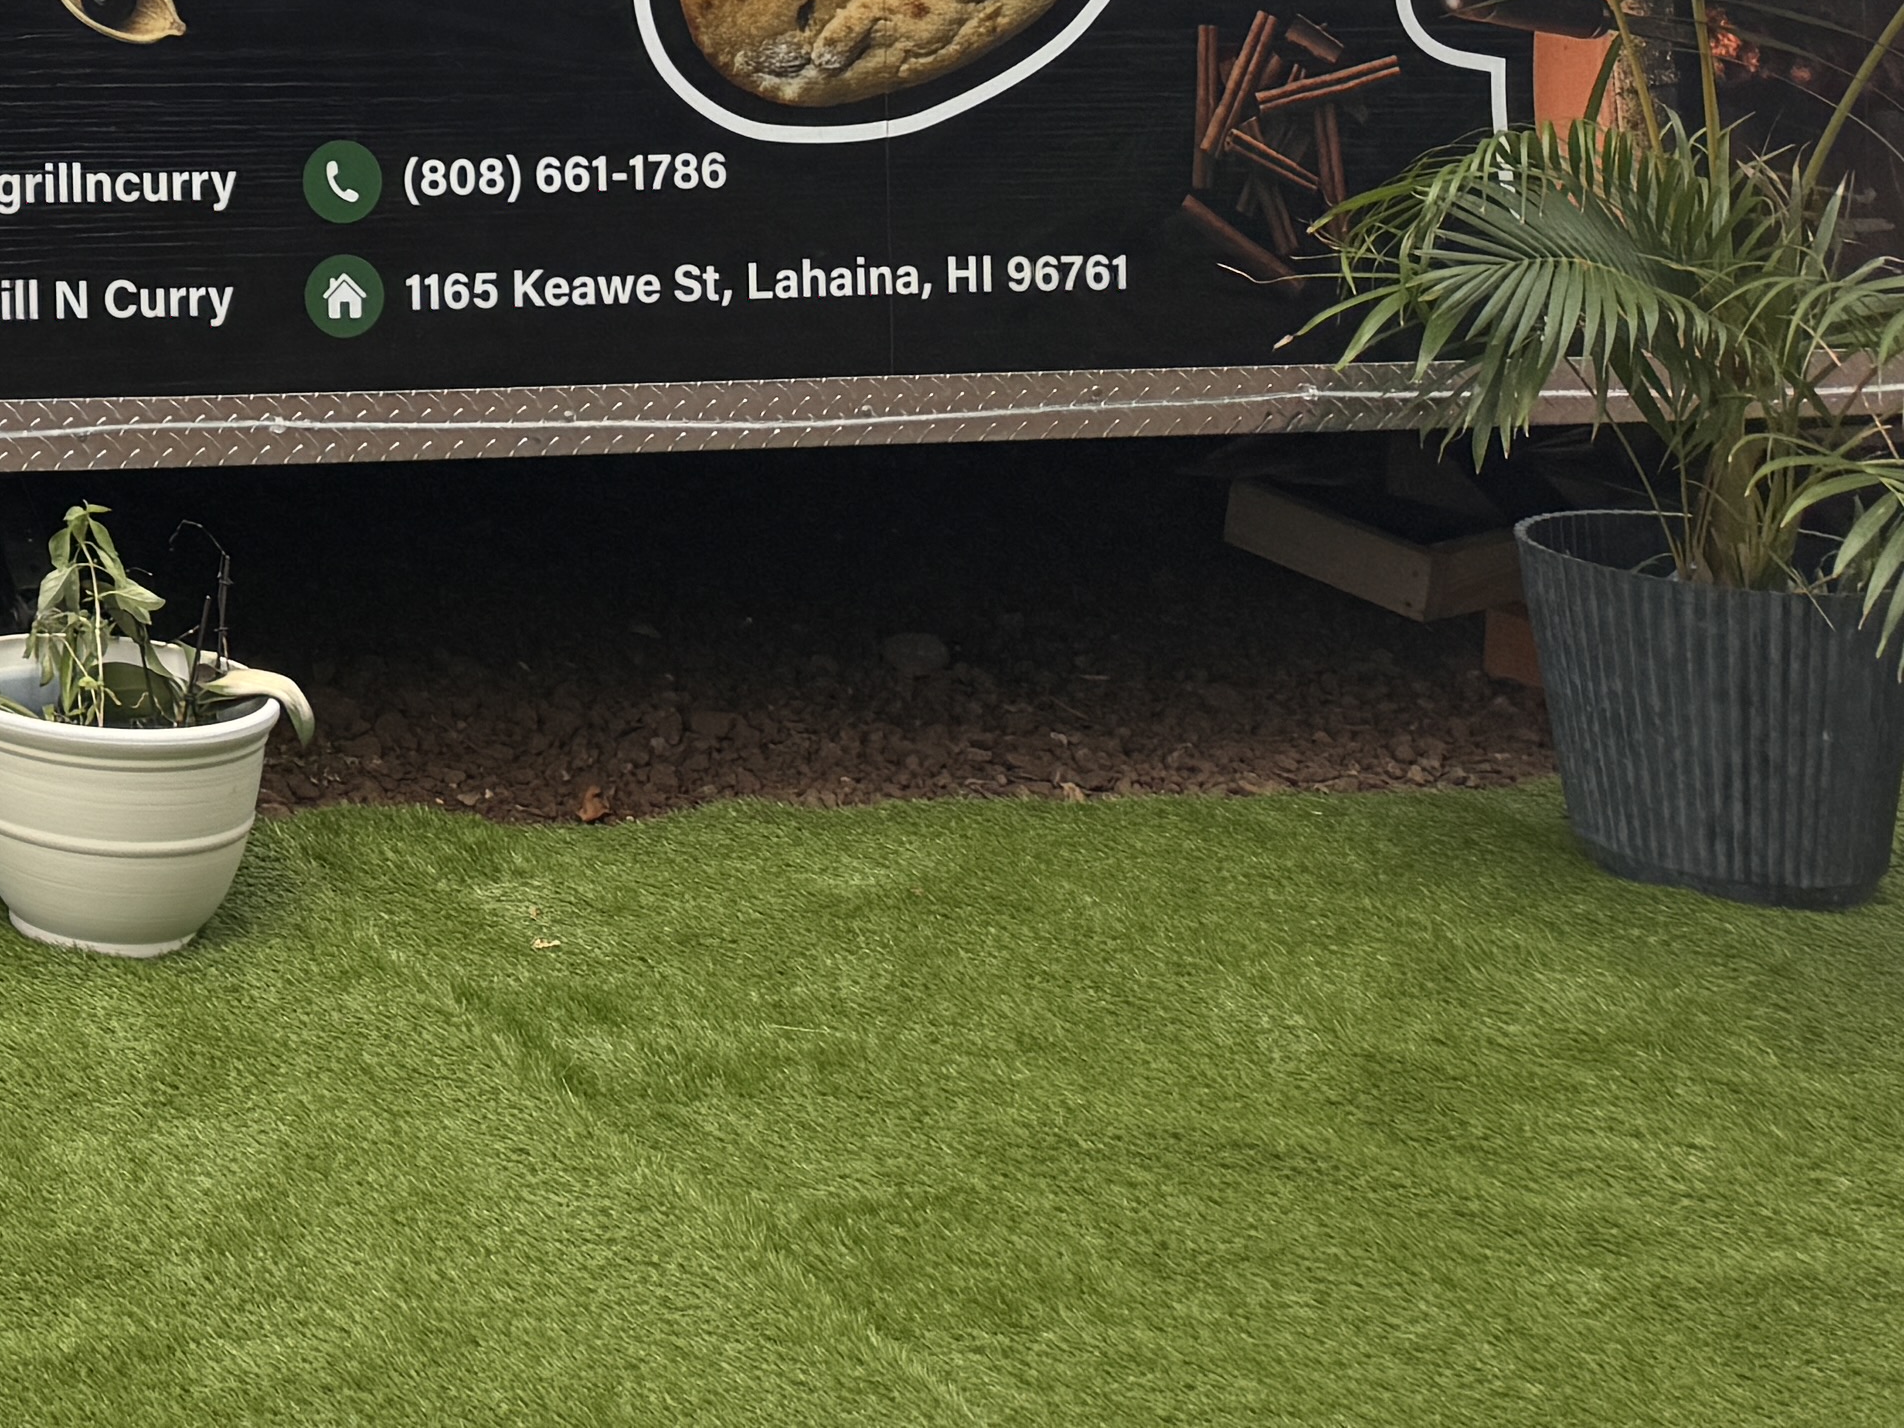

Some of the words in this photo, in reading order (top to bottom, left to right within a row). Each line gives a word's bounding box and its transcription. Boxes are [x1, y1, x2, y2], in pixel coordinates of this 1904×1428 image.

[403, 154, 522, 206] (808)
[535, 151, 728, 194] 661-1786
[54, 280, 89, 320] N
[103, 279, 234, 327] Curry
[405, 272, 498, 311] 1165
[513, 269, 661, 308] Keawe
[674, 264, 733, 307] St,
[747, 256, 932, 300] Lahaina,
[947, 255, 992, 293] HI
[1007, 254, 1128, 292] 96761
